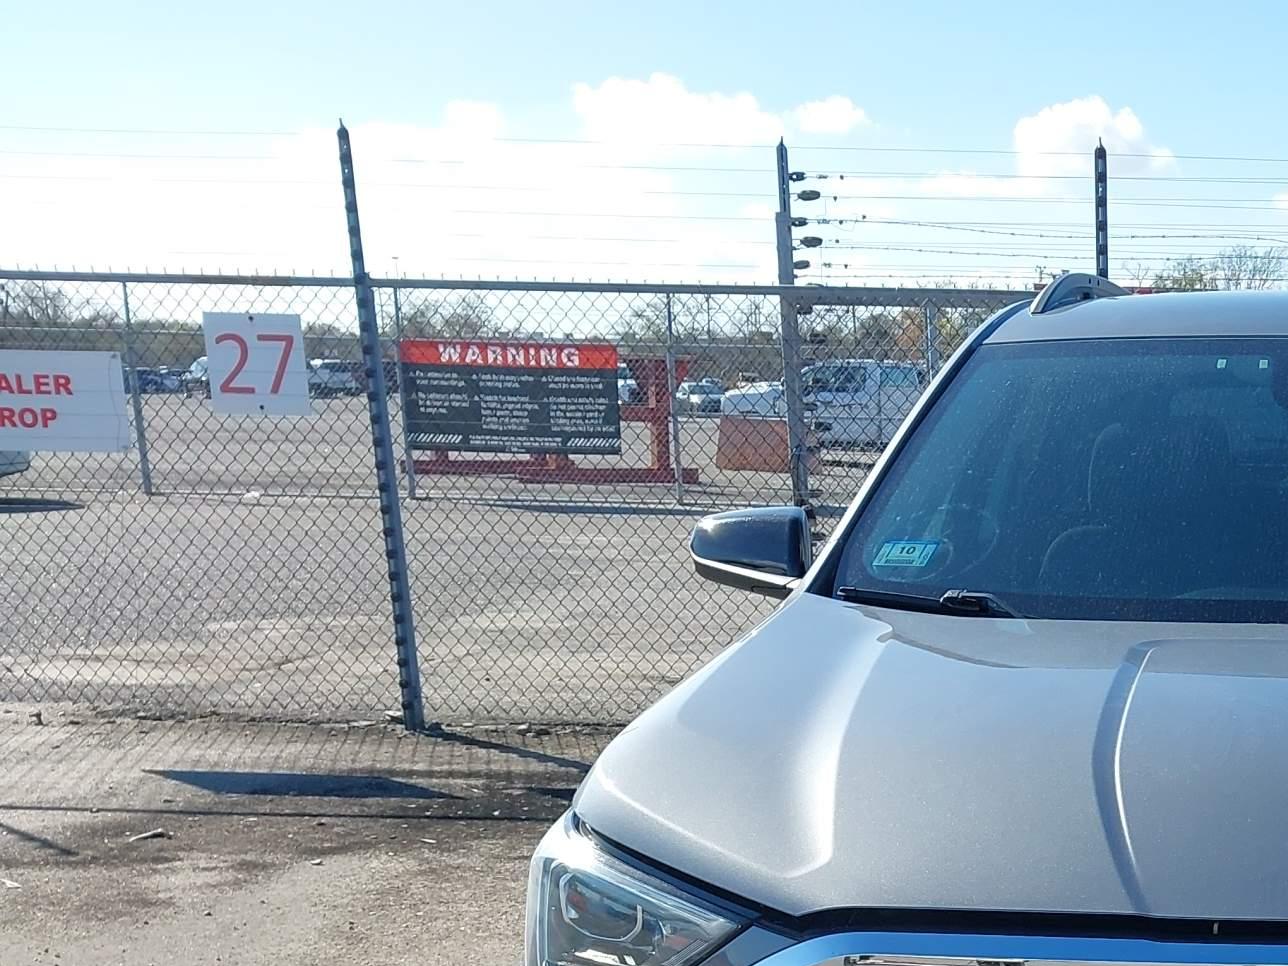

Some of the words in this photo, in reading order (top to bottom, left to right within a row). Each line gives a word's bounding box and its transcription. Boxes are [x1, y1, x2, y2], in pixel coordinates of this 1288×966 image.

[214, 332, 294, 395] 27
[437, 343, 580, 367] WARNING
[0, 373, 73, 396] ALER
[0, 407, 58, 429] ROP
[898, 545, 917, 555] 10
